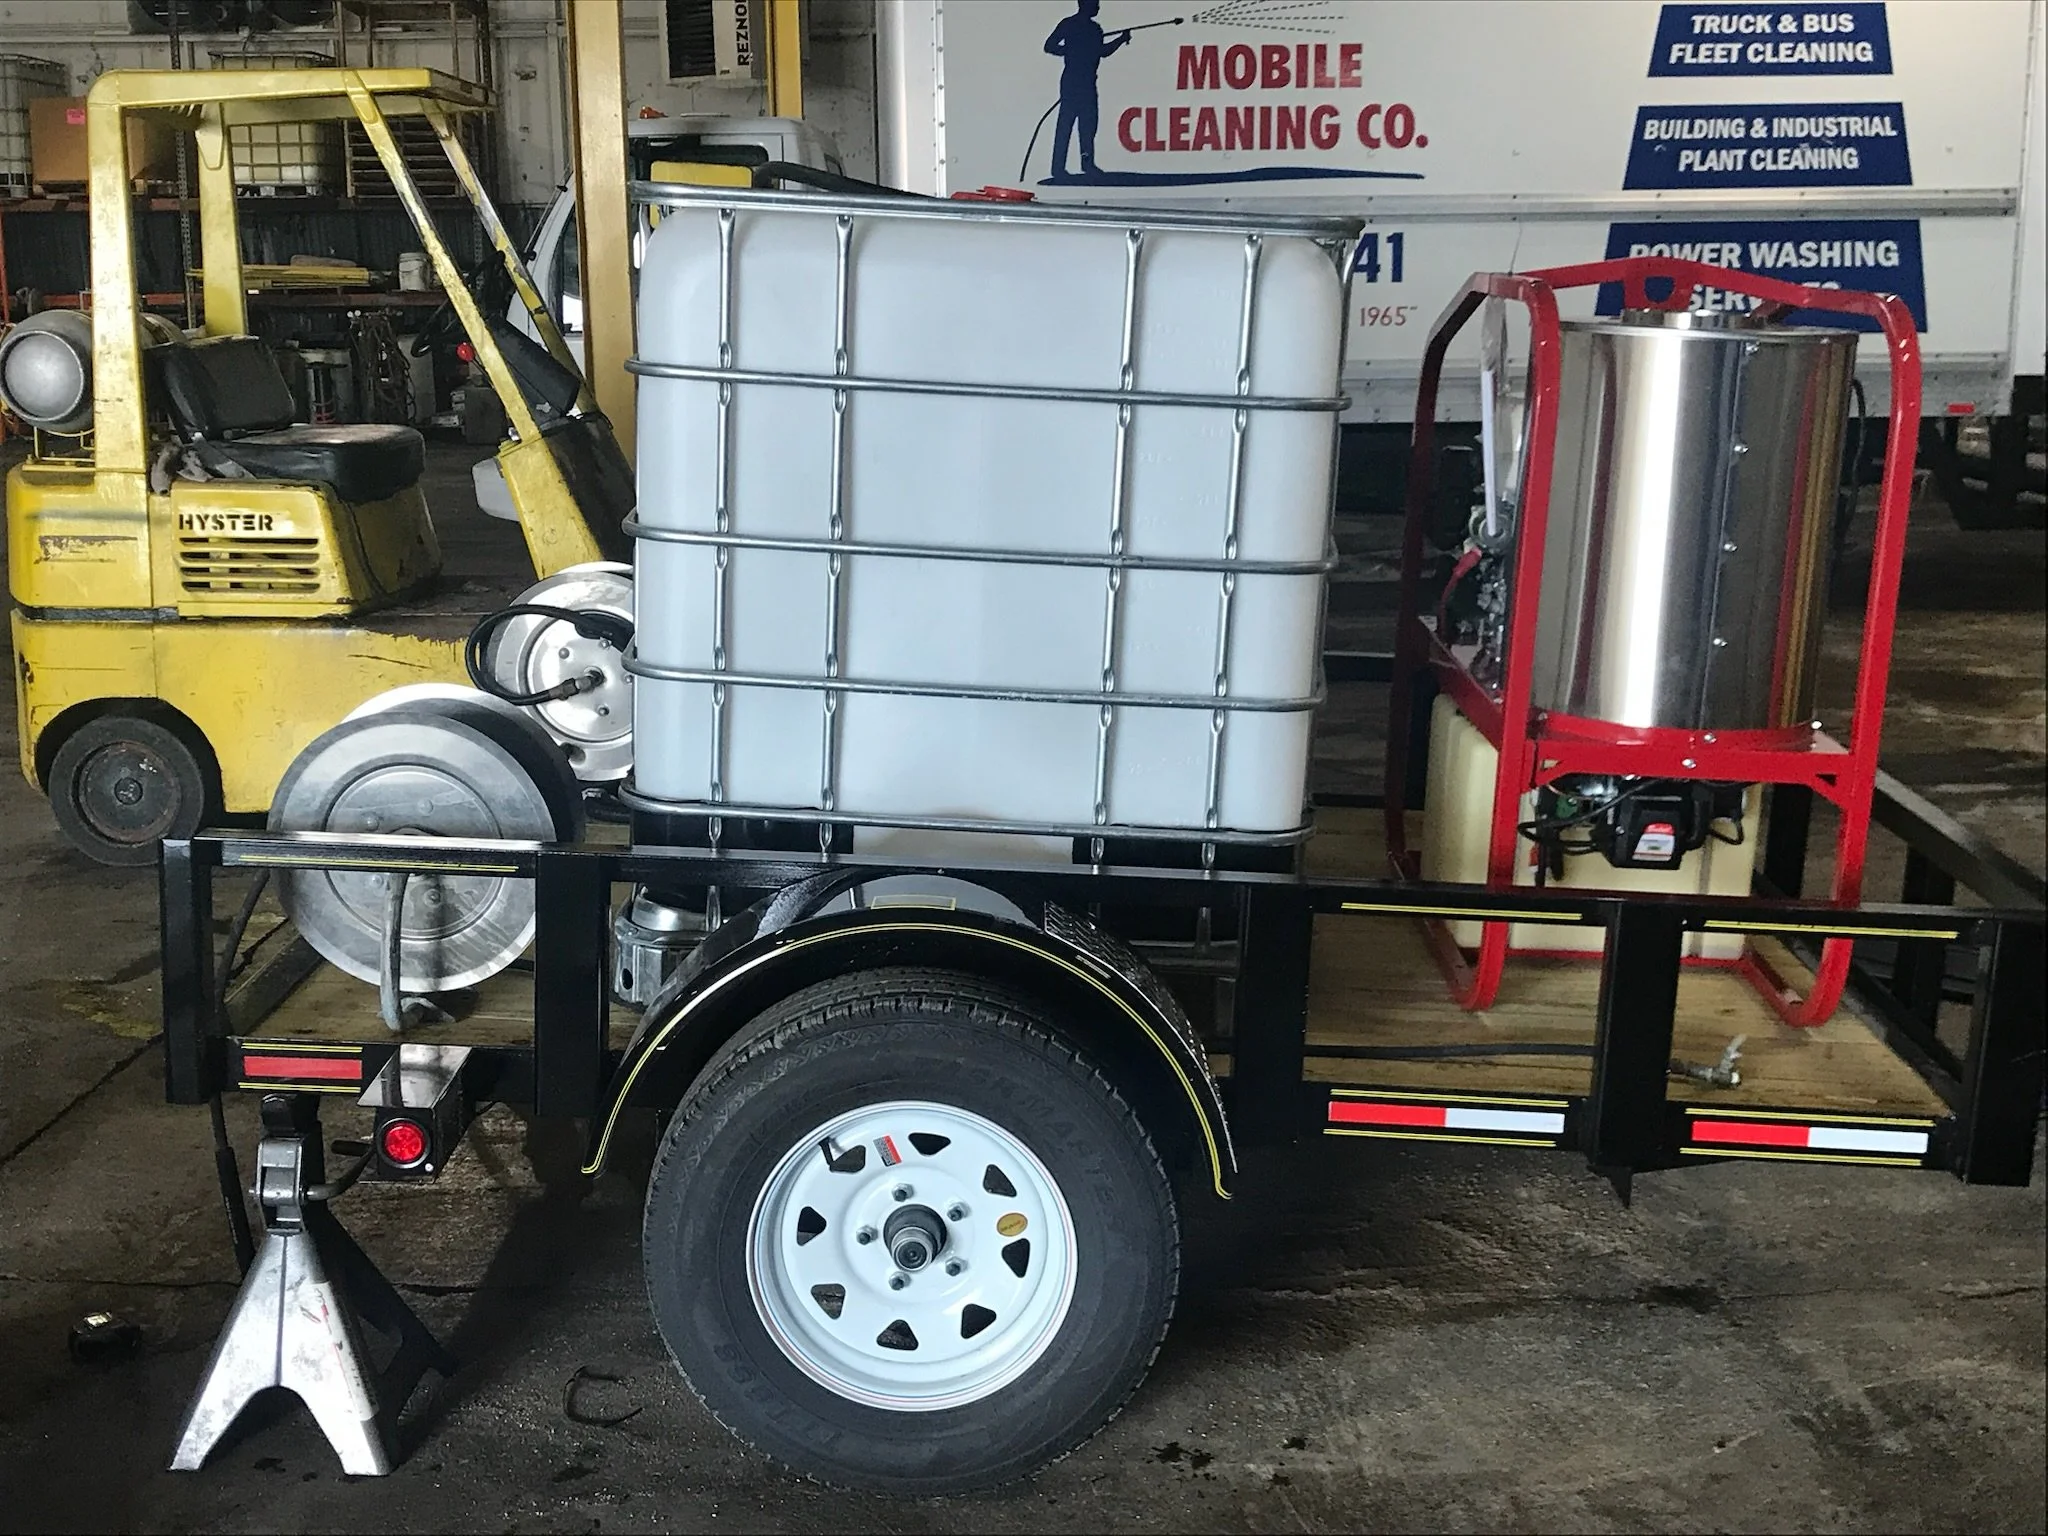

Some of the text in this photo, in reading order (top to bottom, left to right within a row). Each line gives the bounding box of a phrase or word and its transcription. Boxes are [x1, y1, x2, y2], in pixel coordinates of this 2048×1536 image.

[735, 0, 749, 66] REZNO
[1690, 13, 1854, 34] TRUCK & BUS
[1669, 41, 1874, 64] FLEET CLEANING
[1176, 42, 1364, 90] MOBILE
[1117, 103, 1429, 153] CLEANING CO.
[1643, 116, 1898, 140] BUILDING & INDUSTRIAL
[1678, 147, 1859, 172] PLANT CLEANING
[1748, 240, 1899, 268] WASHING
[179, 513, 273, 531] HYSTER
